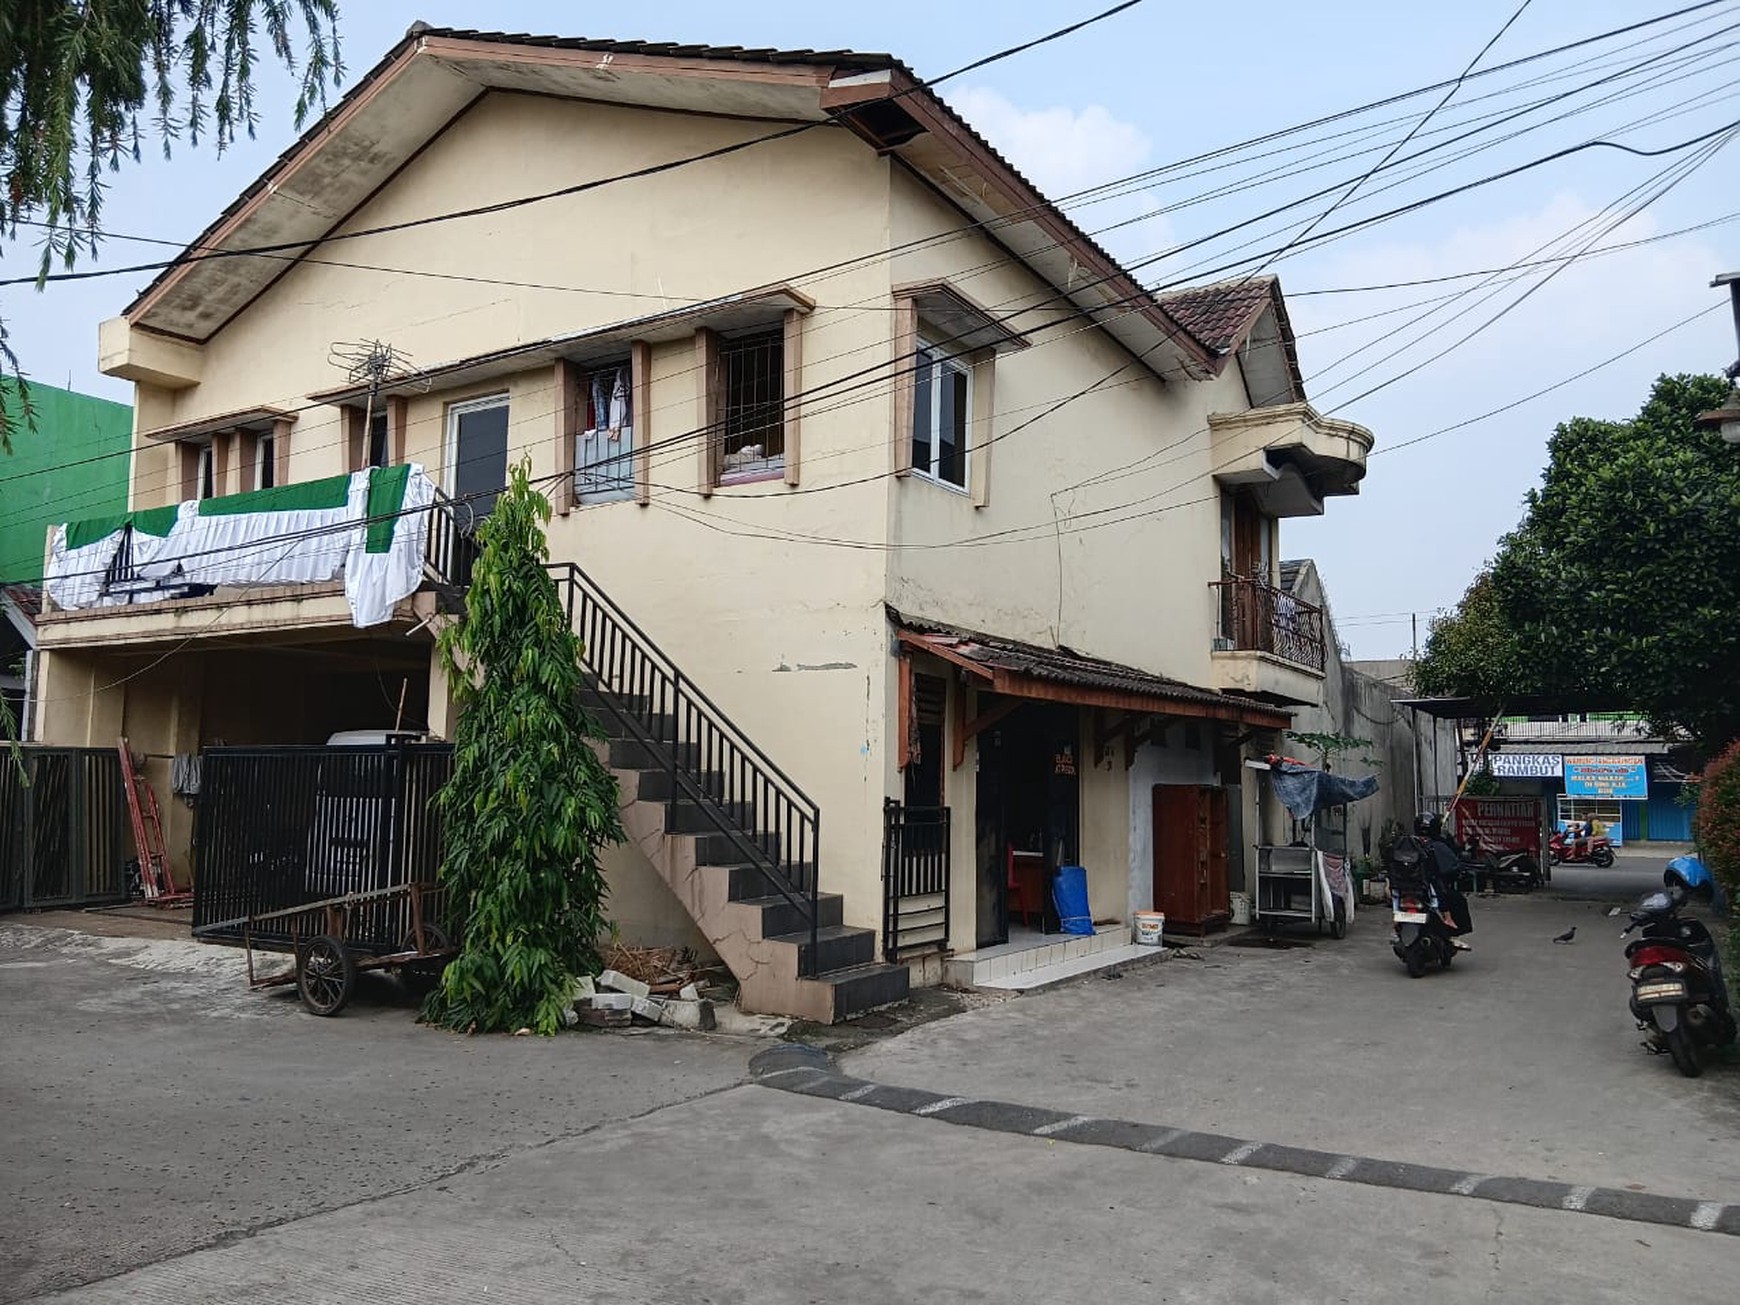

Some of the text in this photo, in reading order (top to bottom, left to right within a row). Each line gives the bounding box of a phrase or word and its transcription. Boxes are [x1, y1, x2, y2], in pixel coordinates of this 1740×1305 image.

[1494, 755, 1560, 765] PANGKAS
[1498, 765, 1556, 775] RAMBUT
[1478, 802, 1534, 816] PERHATIAN
